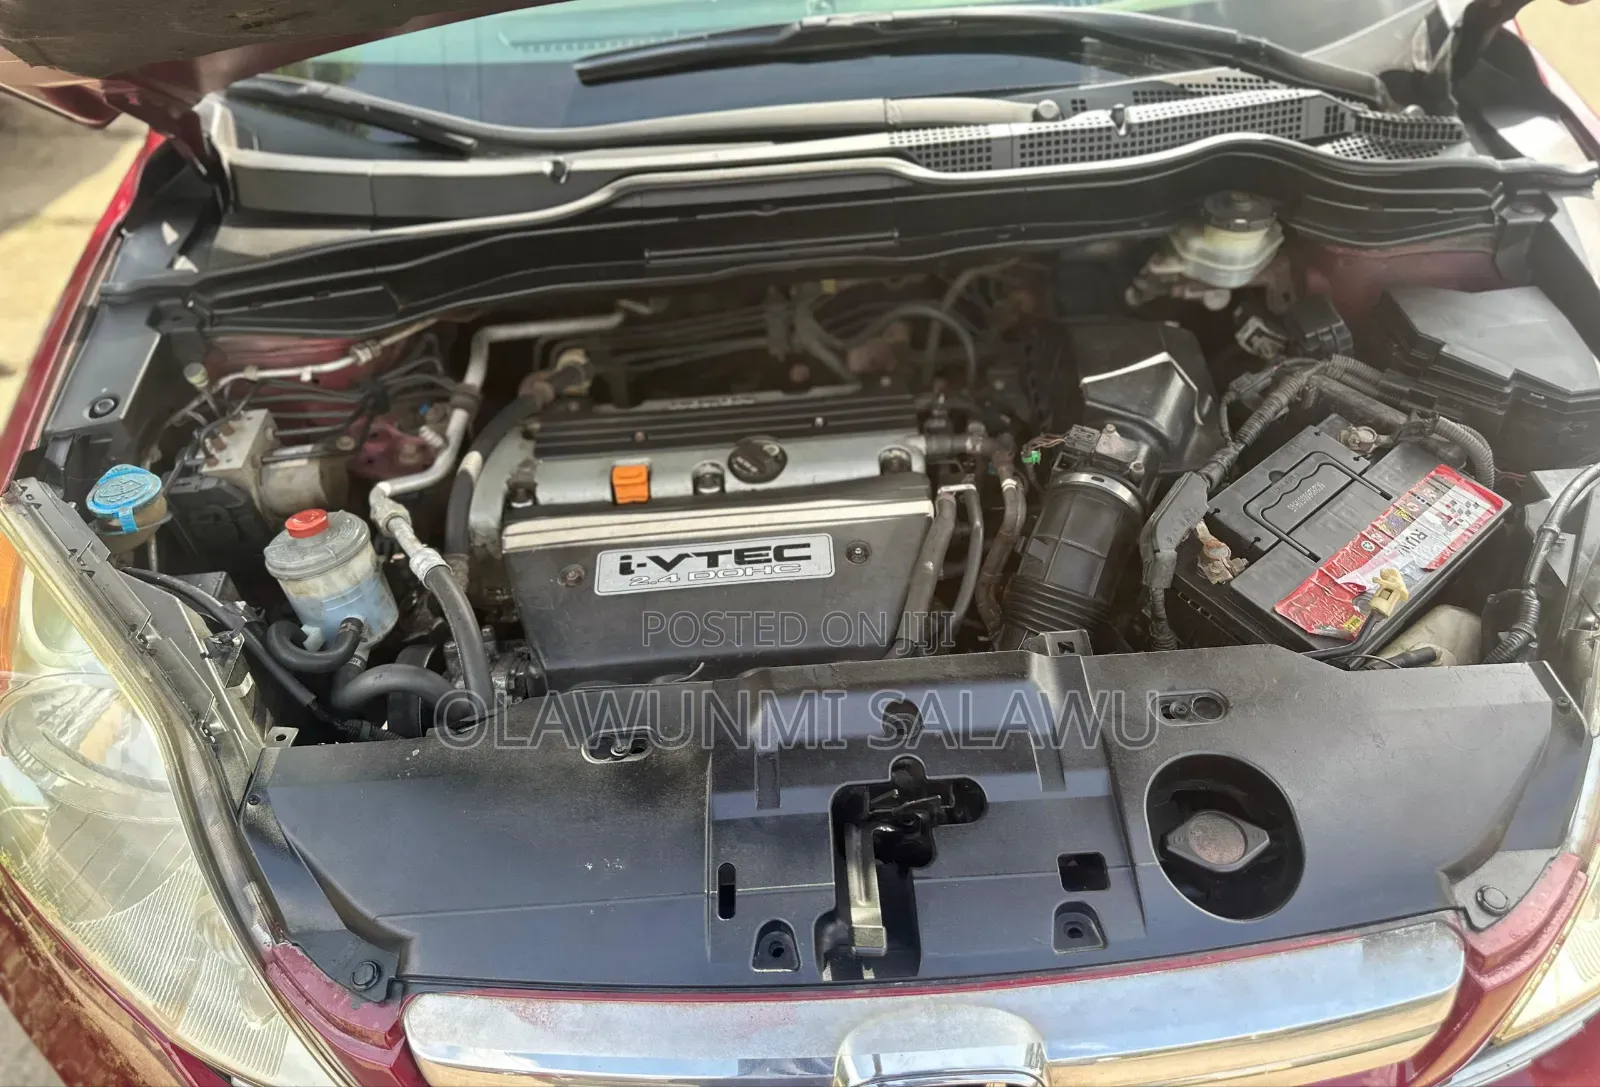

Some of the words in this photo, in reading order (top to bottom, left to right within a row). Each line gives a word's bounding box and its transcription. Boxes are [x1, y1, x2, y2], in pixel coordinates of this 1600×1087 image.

[618, 543, 812, 576] i-VTEC
[628, 573, 681, 587] 2.4
[687, 563, 802, 582] DOHC
